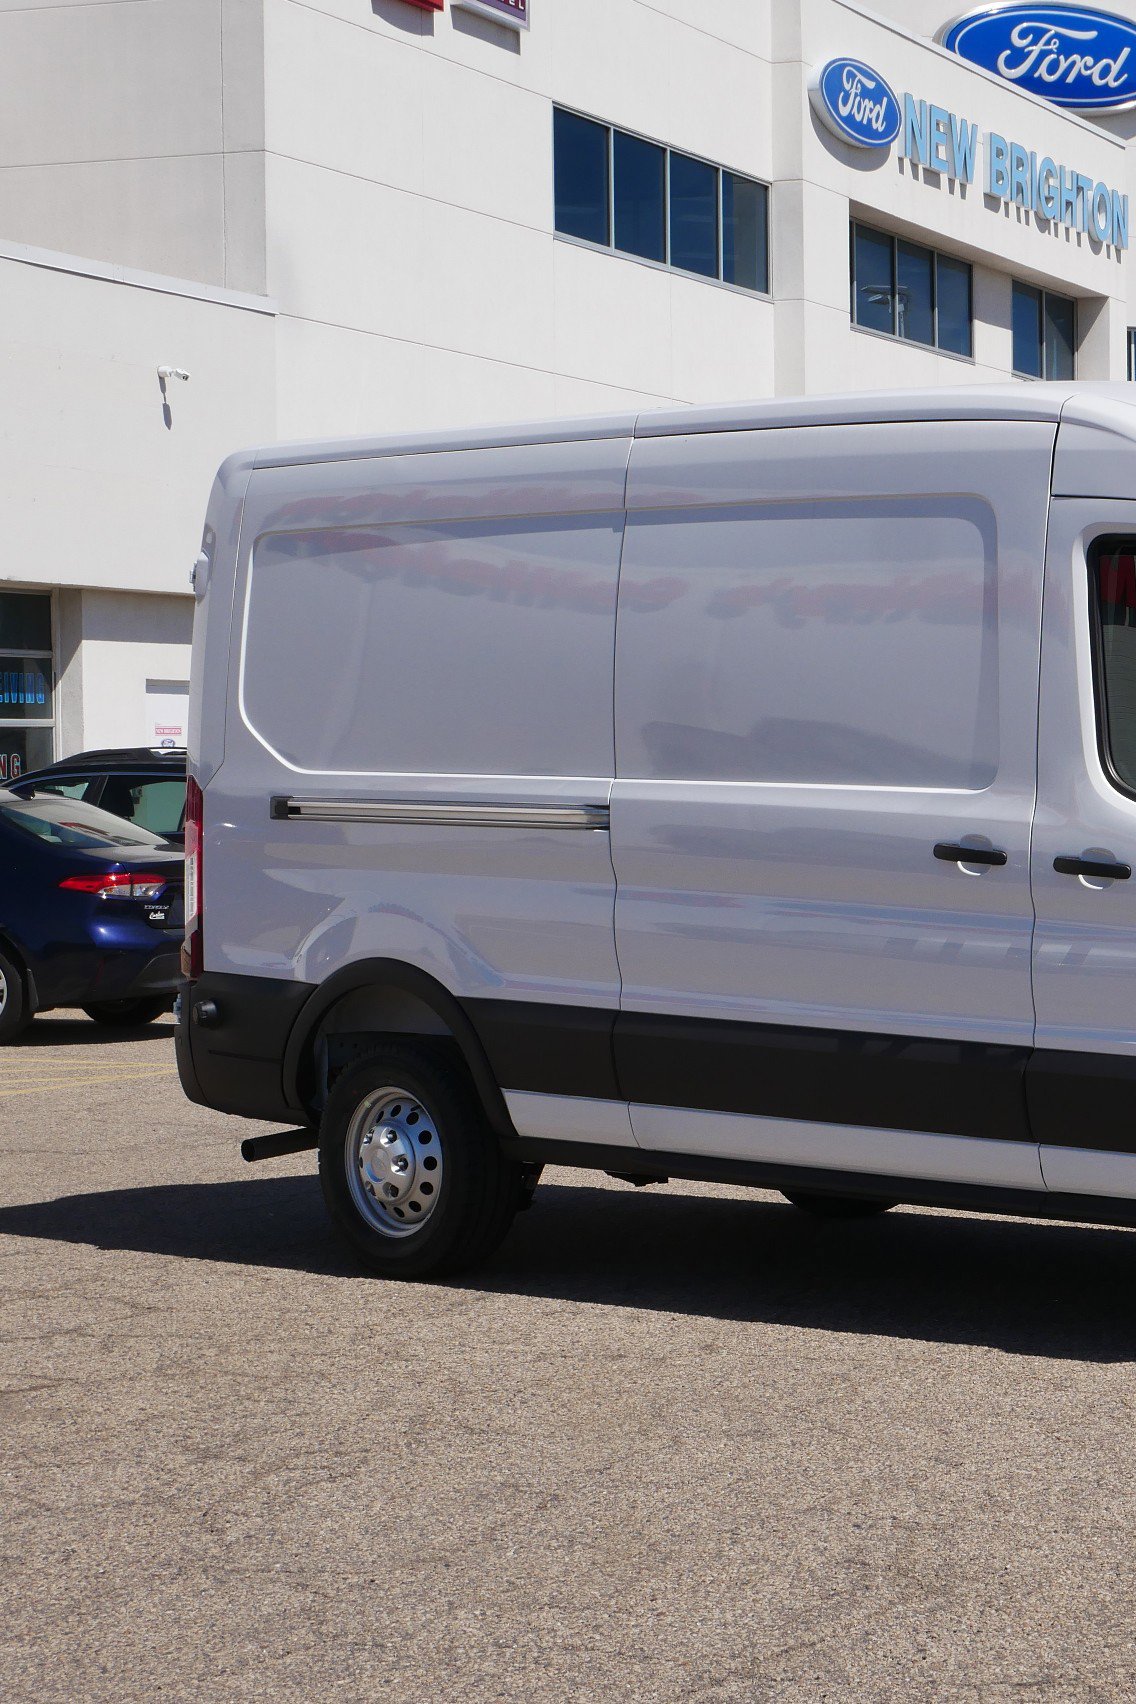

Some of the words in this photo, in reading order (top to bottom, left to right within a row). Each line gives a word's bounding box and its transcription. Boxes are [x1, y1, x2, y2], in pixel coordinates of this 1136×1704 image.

[997, 22, 1131, 88] Ford
[838, 66, 887, 133] Ford
[898, 92, 979, 185] NEW
[983, 131, 1130, 251] BRIGHTON
[0, 671, 46, 704] IVING
